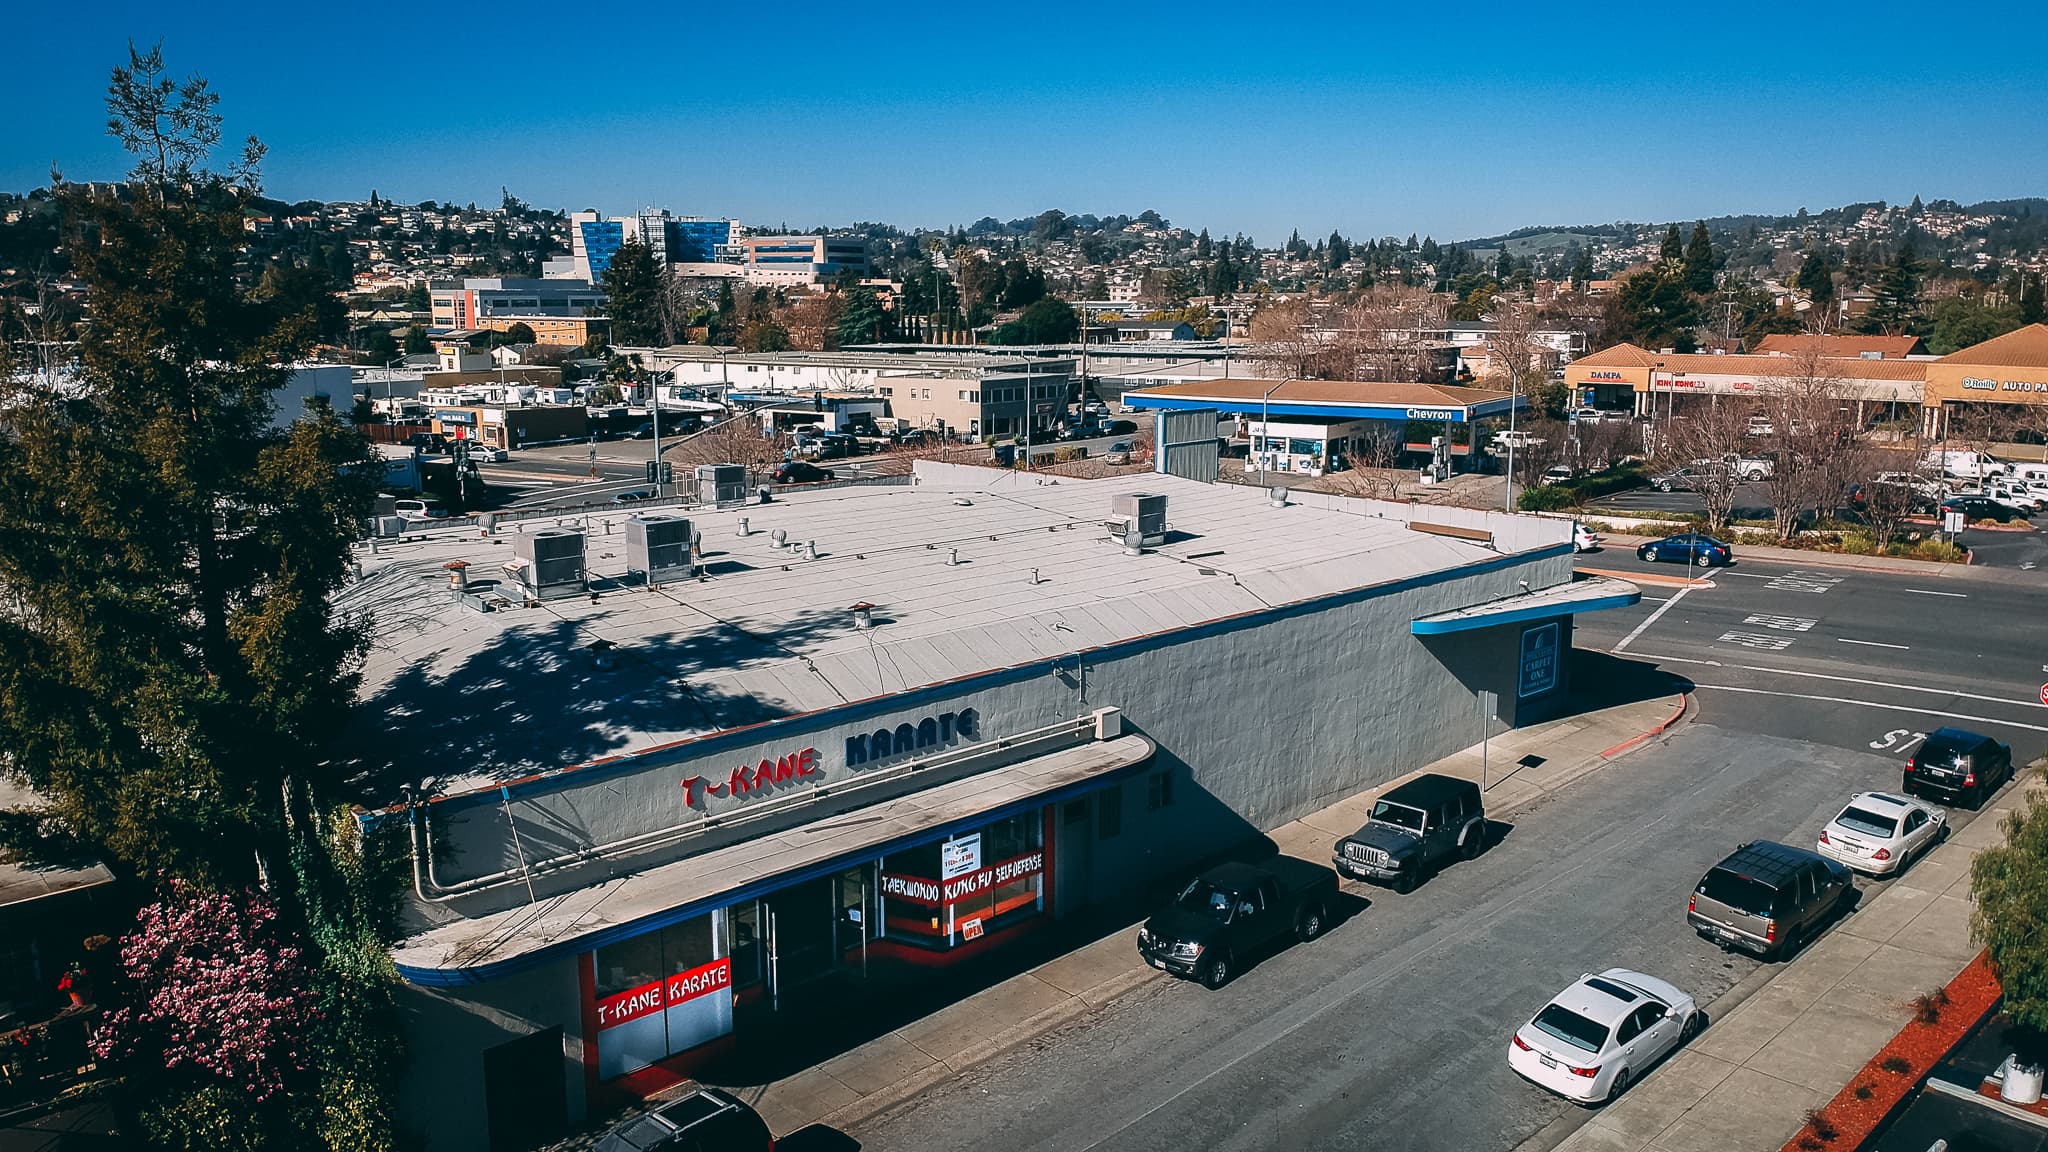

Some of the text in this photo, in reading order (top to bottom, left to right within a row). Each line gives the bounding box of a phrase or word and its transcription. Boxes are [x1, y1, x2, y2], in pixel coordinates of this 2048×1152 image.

[1590, 371, 1622, 380] DAMPA
[1674, 380, 1694, 388] KONG
[2002, 381, 2031, 391] AUTO
[2034, 383, 2048, 392] PA
[1406, 408, 1452, 420] Chevron
[680, 707, 980, 809] T-KANE KARATE
[881, 875, 939, 902] TAEKWONDO
[944, 874, 977, 901] KUNG
[977, 870, 993, 890] FU
[995, 862, 1013, 884] SELF
[1012, 853, 1042, 878] DEFENSE
[597, 964, 727, 1025] T-KANE KARATE
